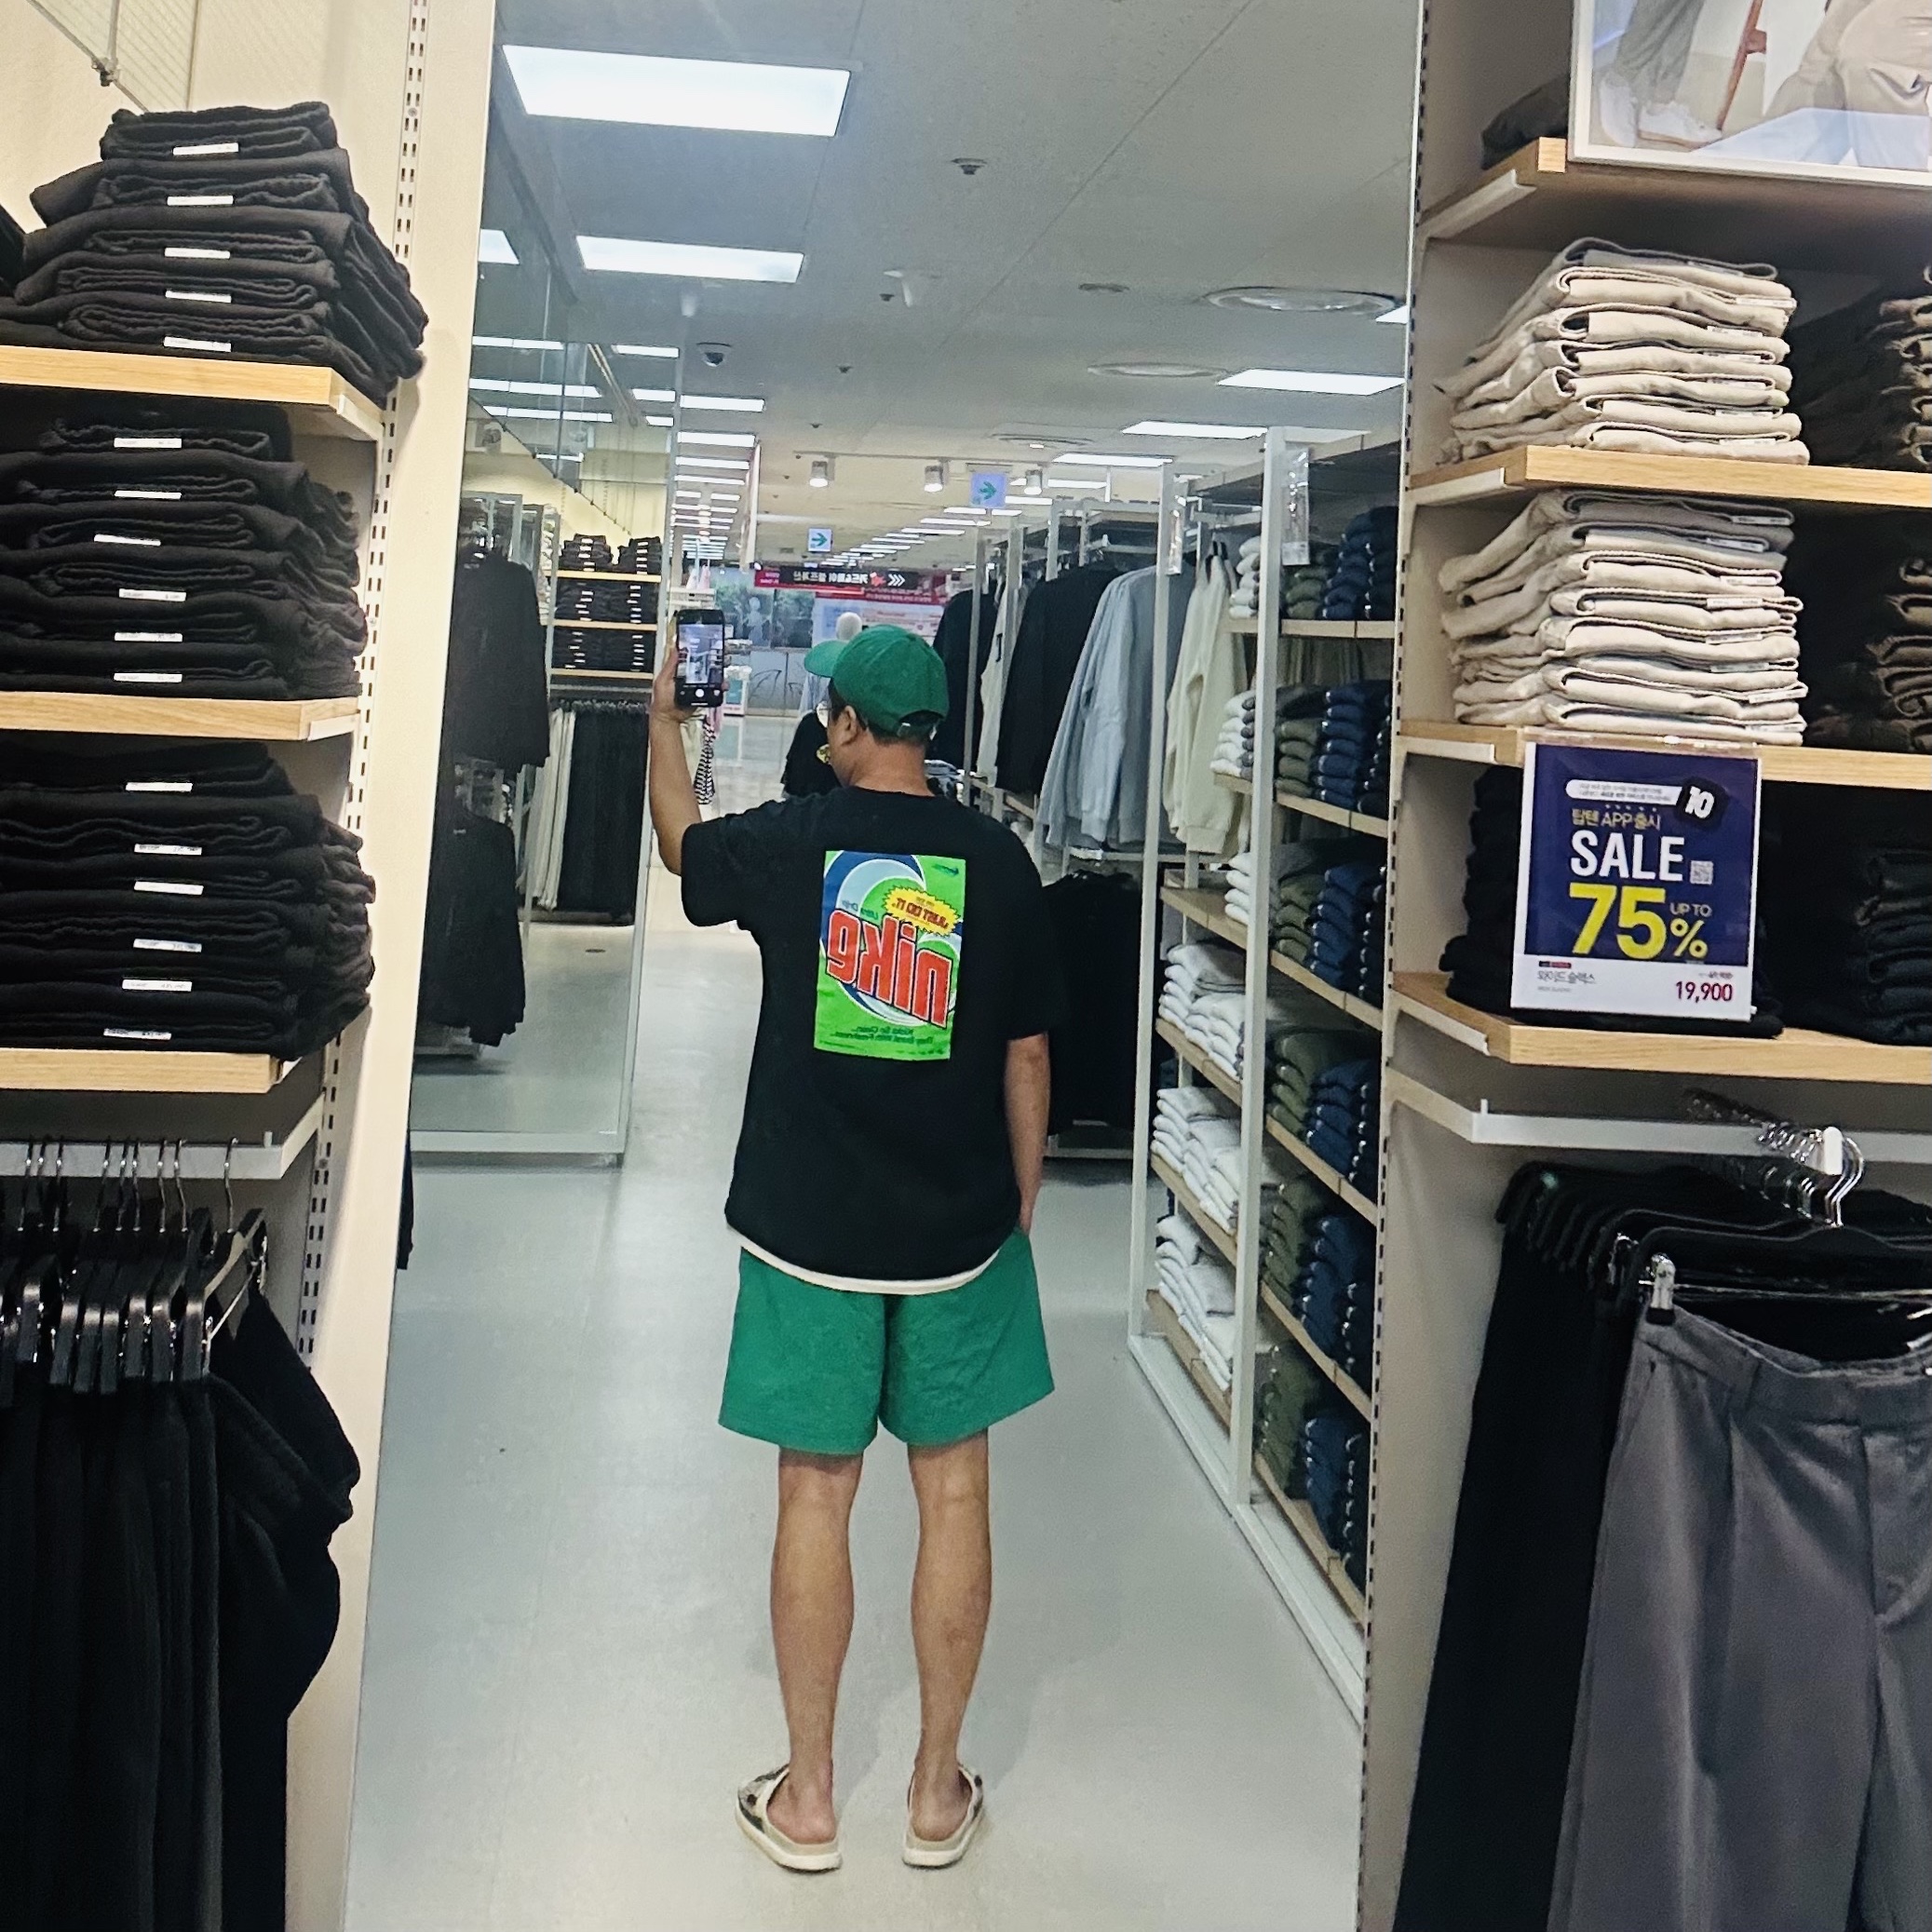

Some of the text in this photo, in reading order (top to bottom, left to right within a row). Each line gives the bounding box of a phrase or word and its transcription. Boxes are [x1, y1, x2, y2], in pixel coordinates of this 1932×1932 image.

[1684, 786, 1715, 819] 10
[1601, 812, 1632, 828] APP
[1571, 830, 1685, 882] SALE
[1669, 902, 1712, 917] UP TO
[1675, 980, 1733, 1003] 19,900
